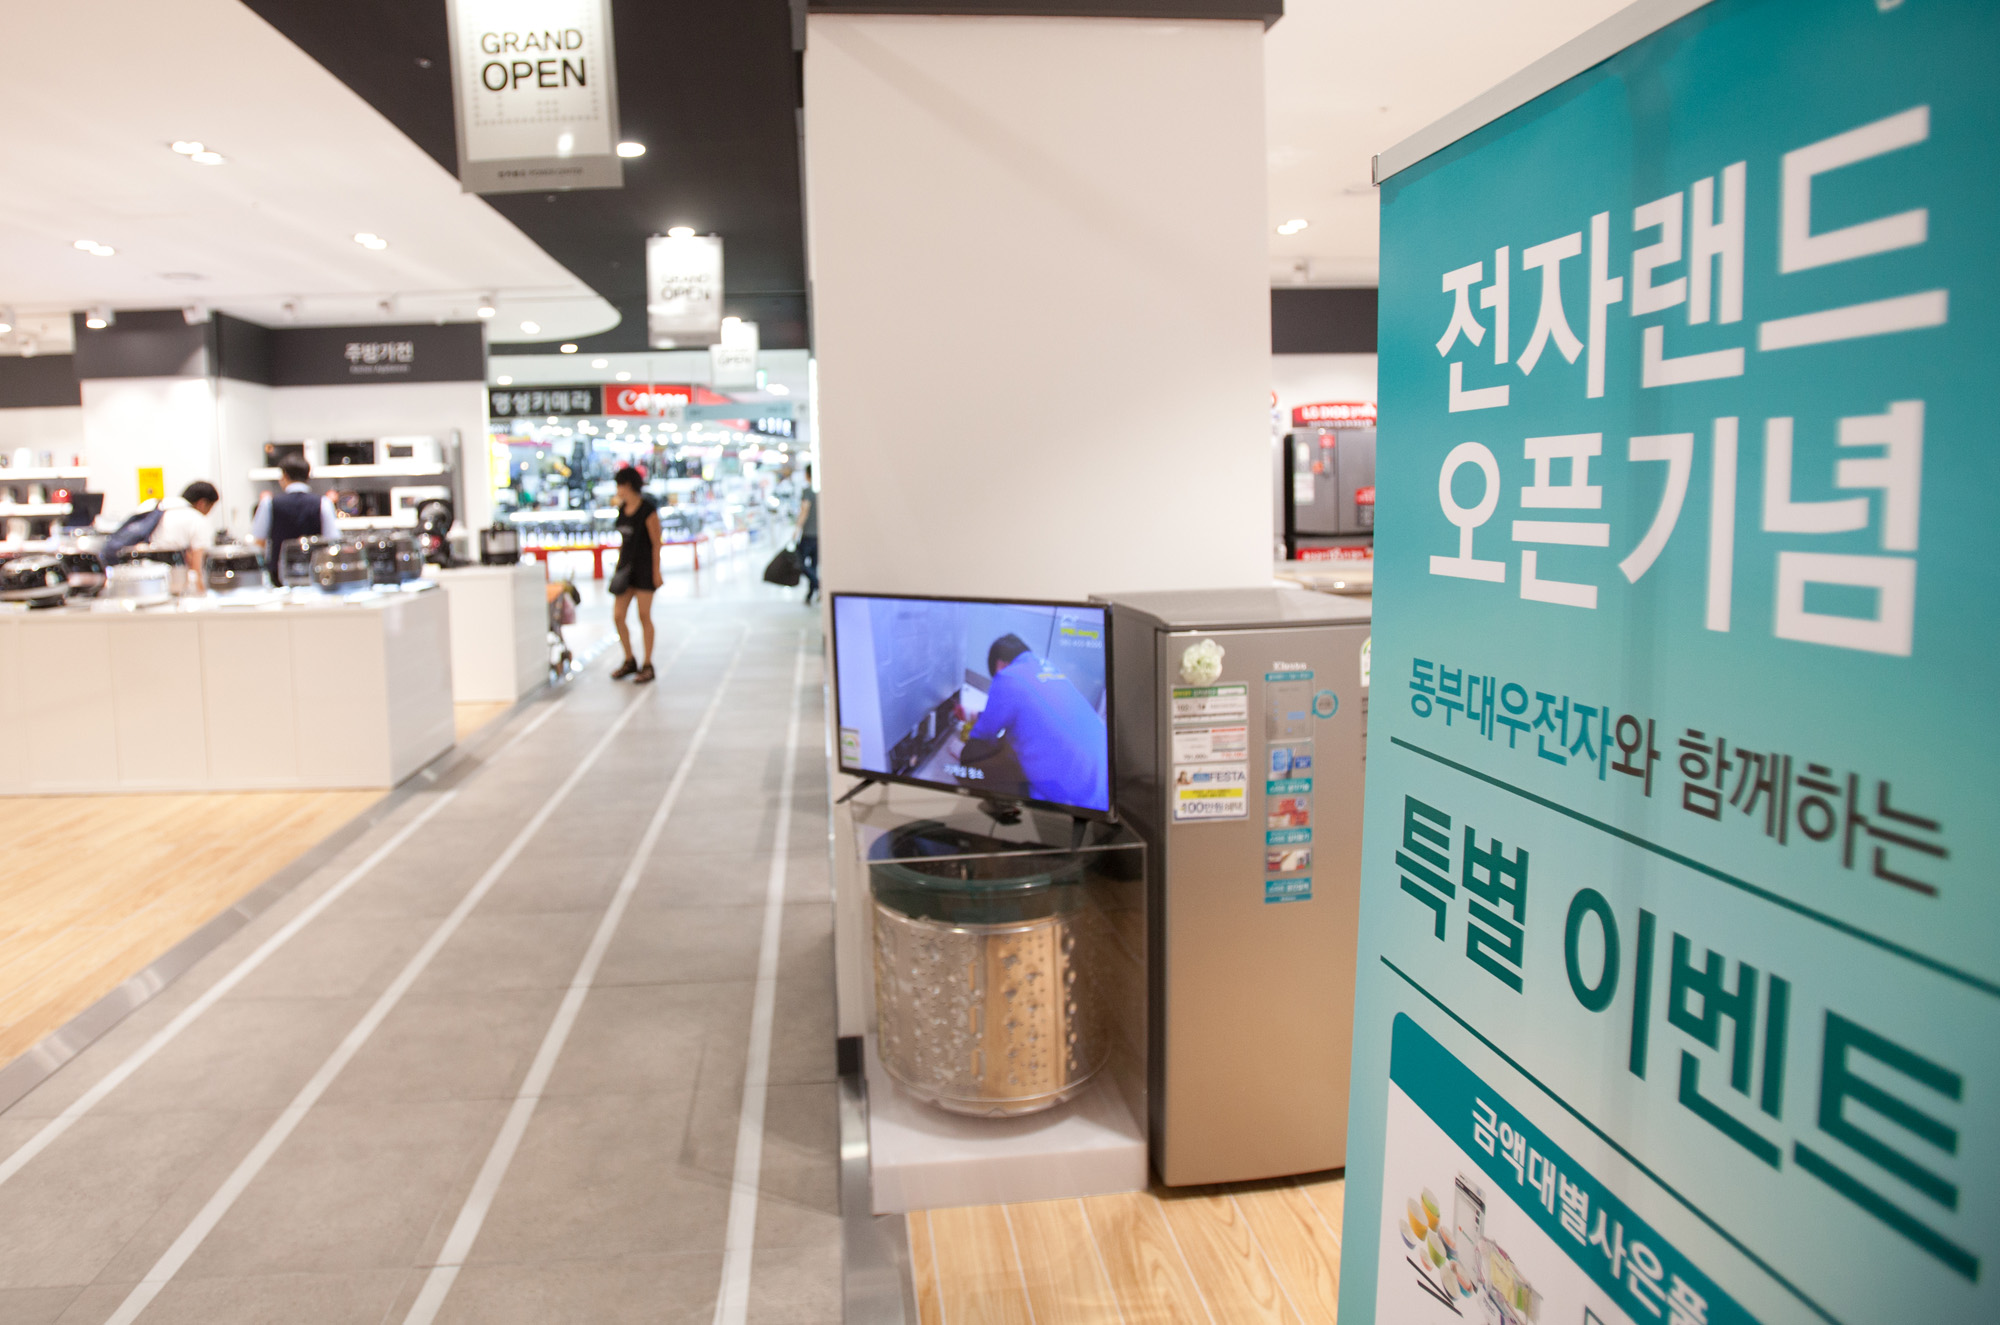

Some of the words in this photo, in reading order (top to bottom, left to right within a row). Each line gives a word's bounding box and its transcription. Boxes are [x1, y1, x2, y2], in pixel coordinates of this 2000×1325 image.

[481, 29, 583, 55] GRAND
[482, 57, 586, 91] OPEN
[1435, 105, 1949, 413] 전자랜드
[343, 341, 415, 364] 주방가전
[1429, 400, 1926, 657] 오픈기념
[1210, 770, 1246, 783] FESTA
[1409, 657, 1661, 797] 동부대우전자와
[1678, 728, 1951, 898] 함께하는
[1394, 794, 1529, 995] 특별
[1564, 887, 1981, 1285] 이벤트
